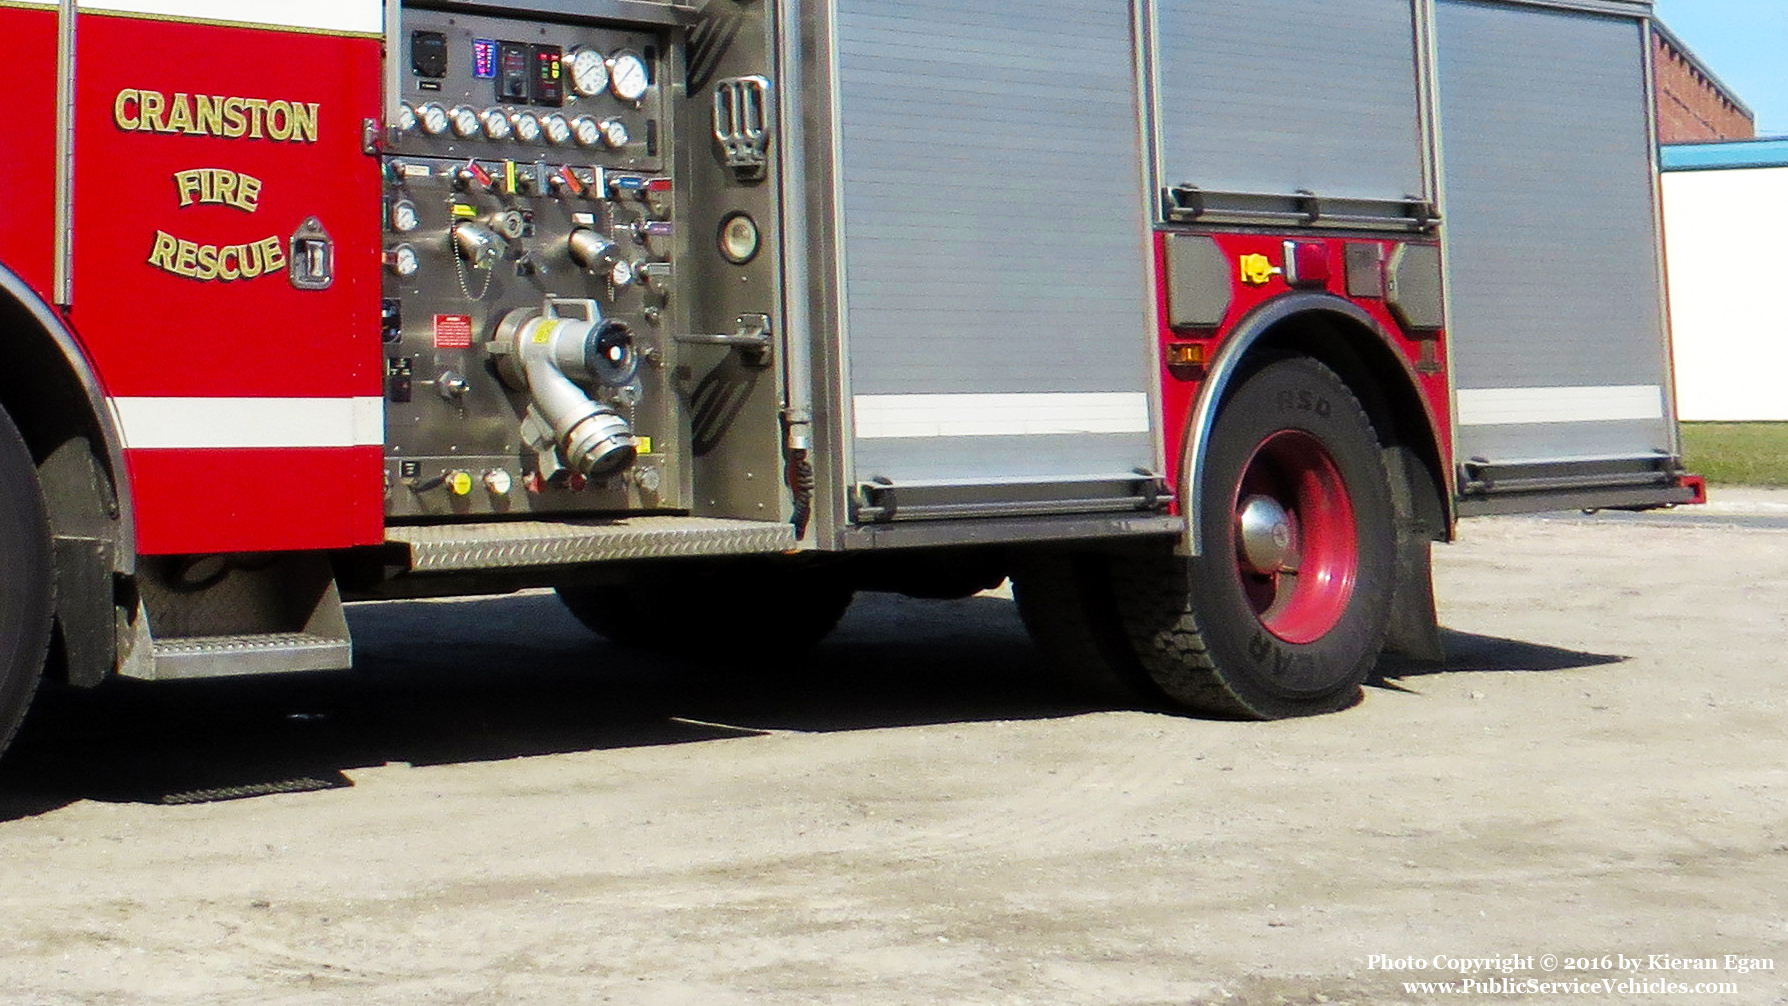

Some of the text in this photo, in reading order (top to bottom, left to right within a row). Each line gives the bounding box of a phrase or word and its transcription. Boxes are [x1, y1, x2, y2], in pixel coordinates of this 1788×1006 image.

[114, 88, 321, 143] CRANSTON
[173, 168, 262, 213] FIRE
[147, 229, 287, 281] RESCUE
